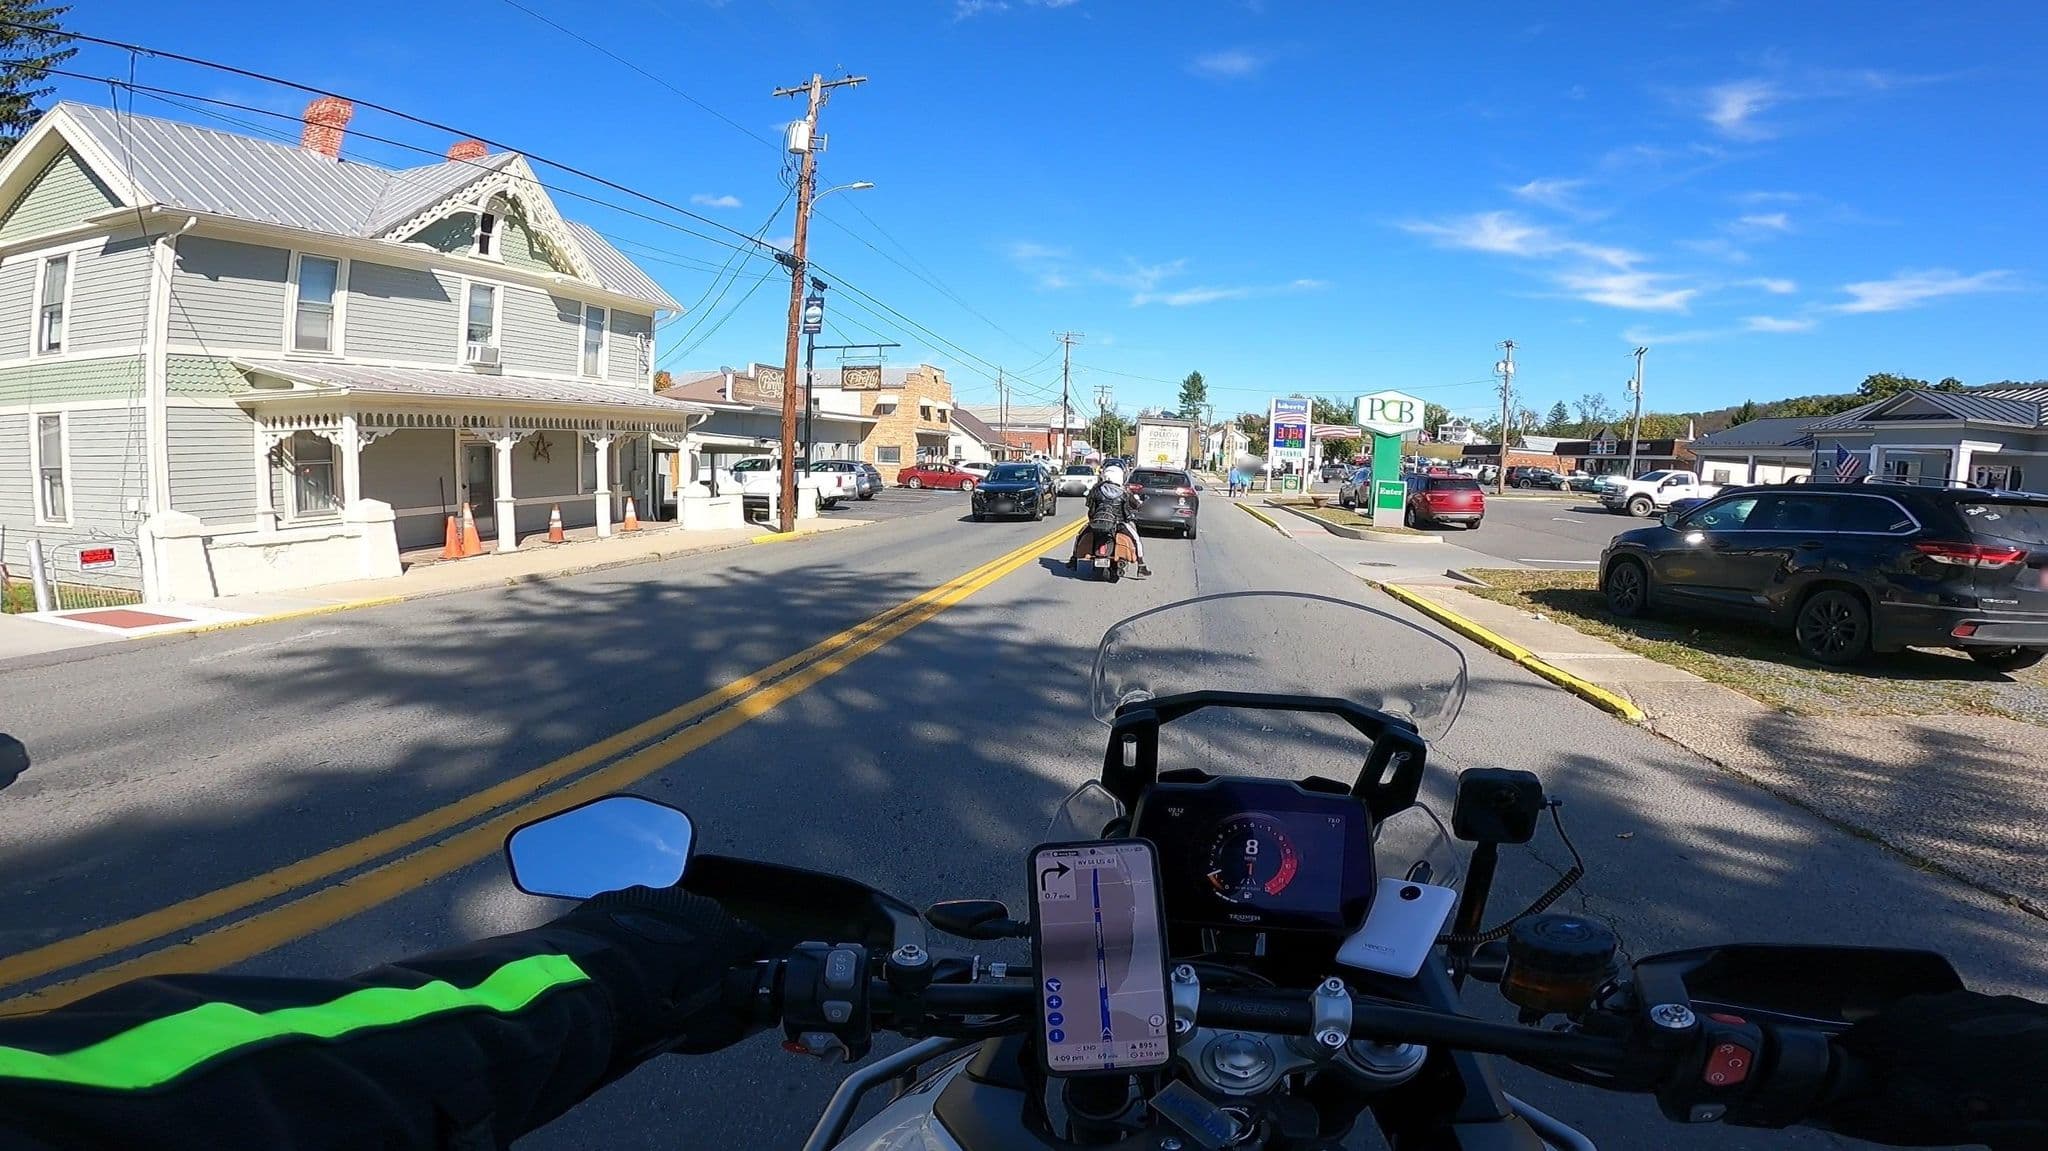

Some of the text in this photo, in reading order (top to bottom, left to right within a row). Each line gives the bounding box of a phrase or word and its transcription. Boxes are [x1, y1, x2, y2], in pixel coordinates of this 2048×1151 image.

[843, 369, 880, 388] Firefly
[1368, 398, 1414, 424] PCB
[1148, 440, 1180, 449] FRESH
[1245, 839, 1259, 855] 8
[1228, 913, 1261, 921] TRIUMPH
